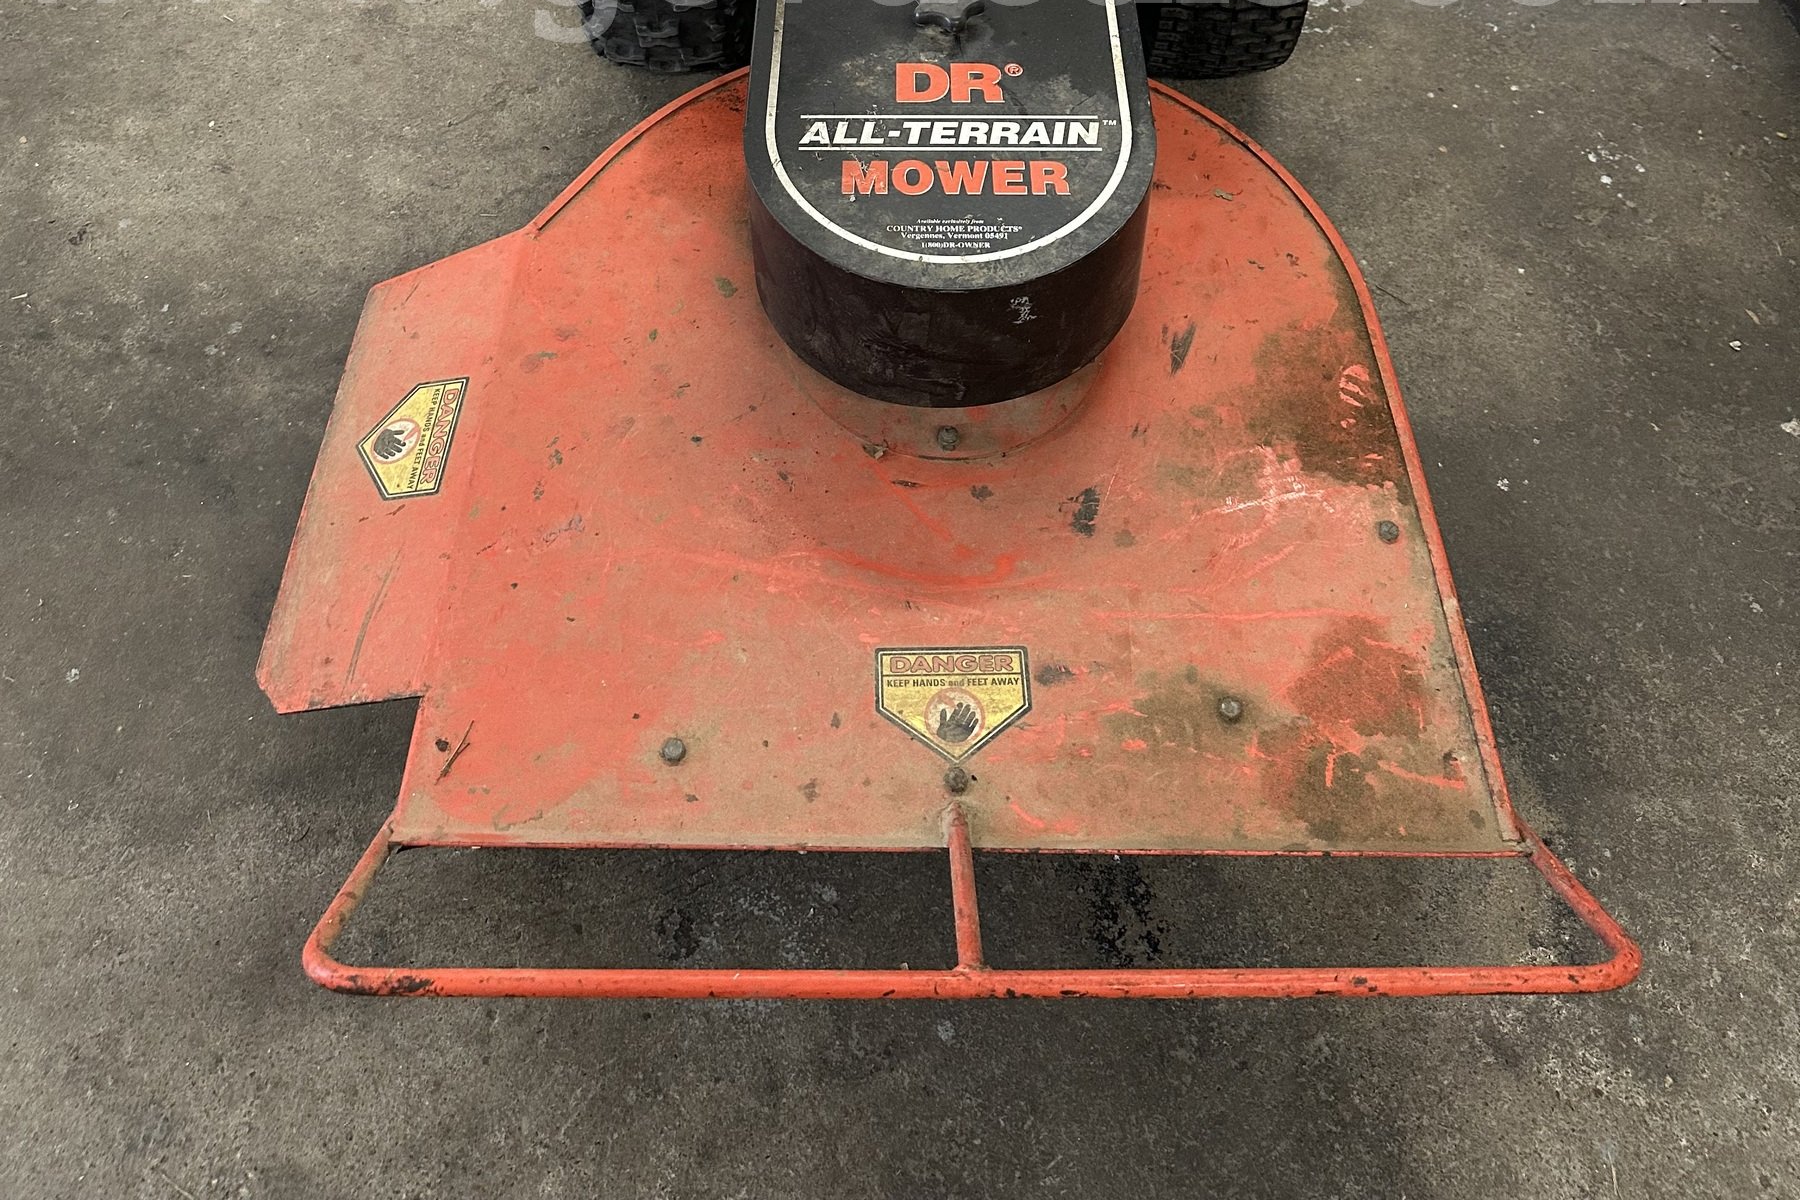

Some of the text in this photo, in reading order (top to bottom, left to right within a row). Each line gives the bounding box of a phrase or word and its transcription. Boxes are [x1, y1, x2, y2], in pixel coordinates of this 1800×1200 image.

[841, 159, 1071, 195] MOWER
[900, 232, 946, 240] Vergennes,
[407, 388, 441, 490] KEEP HANDS and FEET AWAY
[420, 388, 460, 484] DANGER
[889, 654, 1014, 674] DANGER
[887, 677, 1020, 688] KEEP HANDS and FEET AWAY
